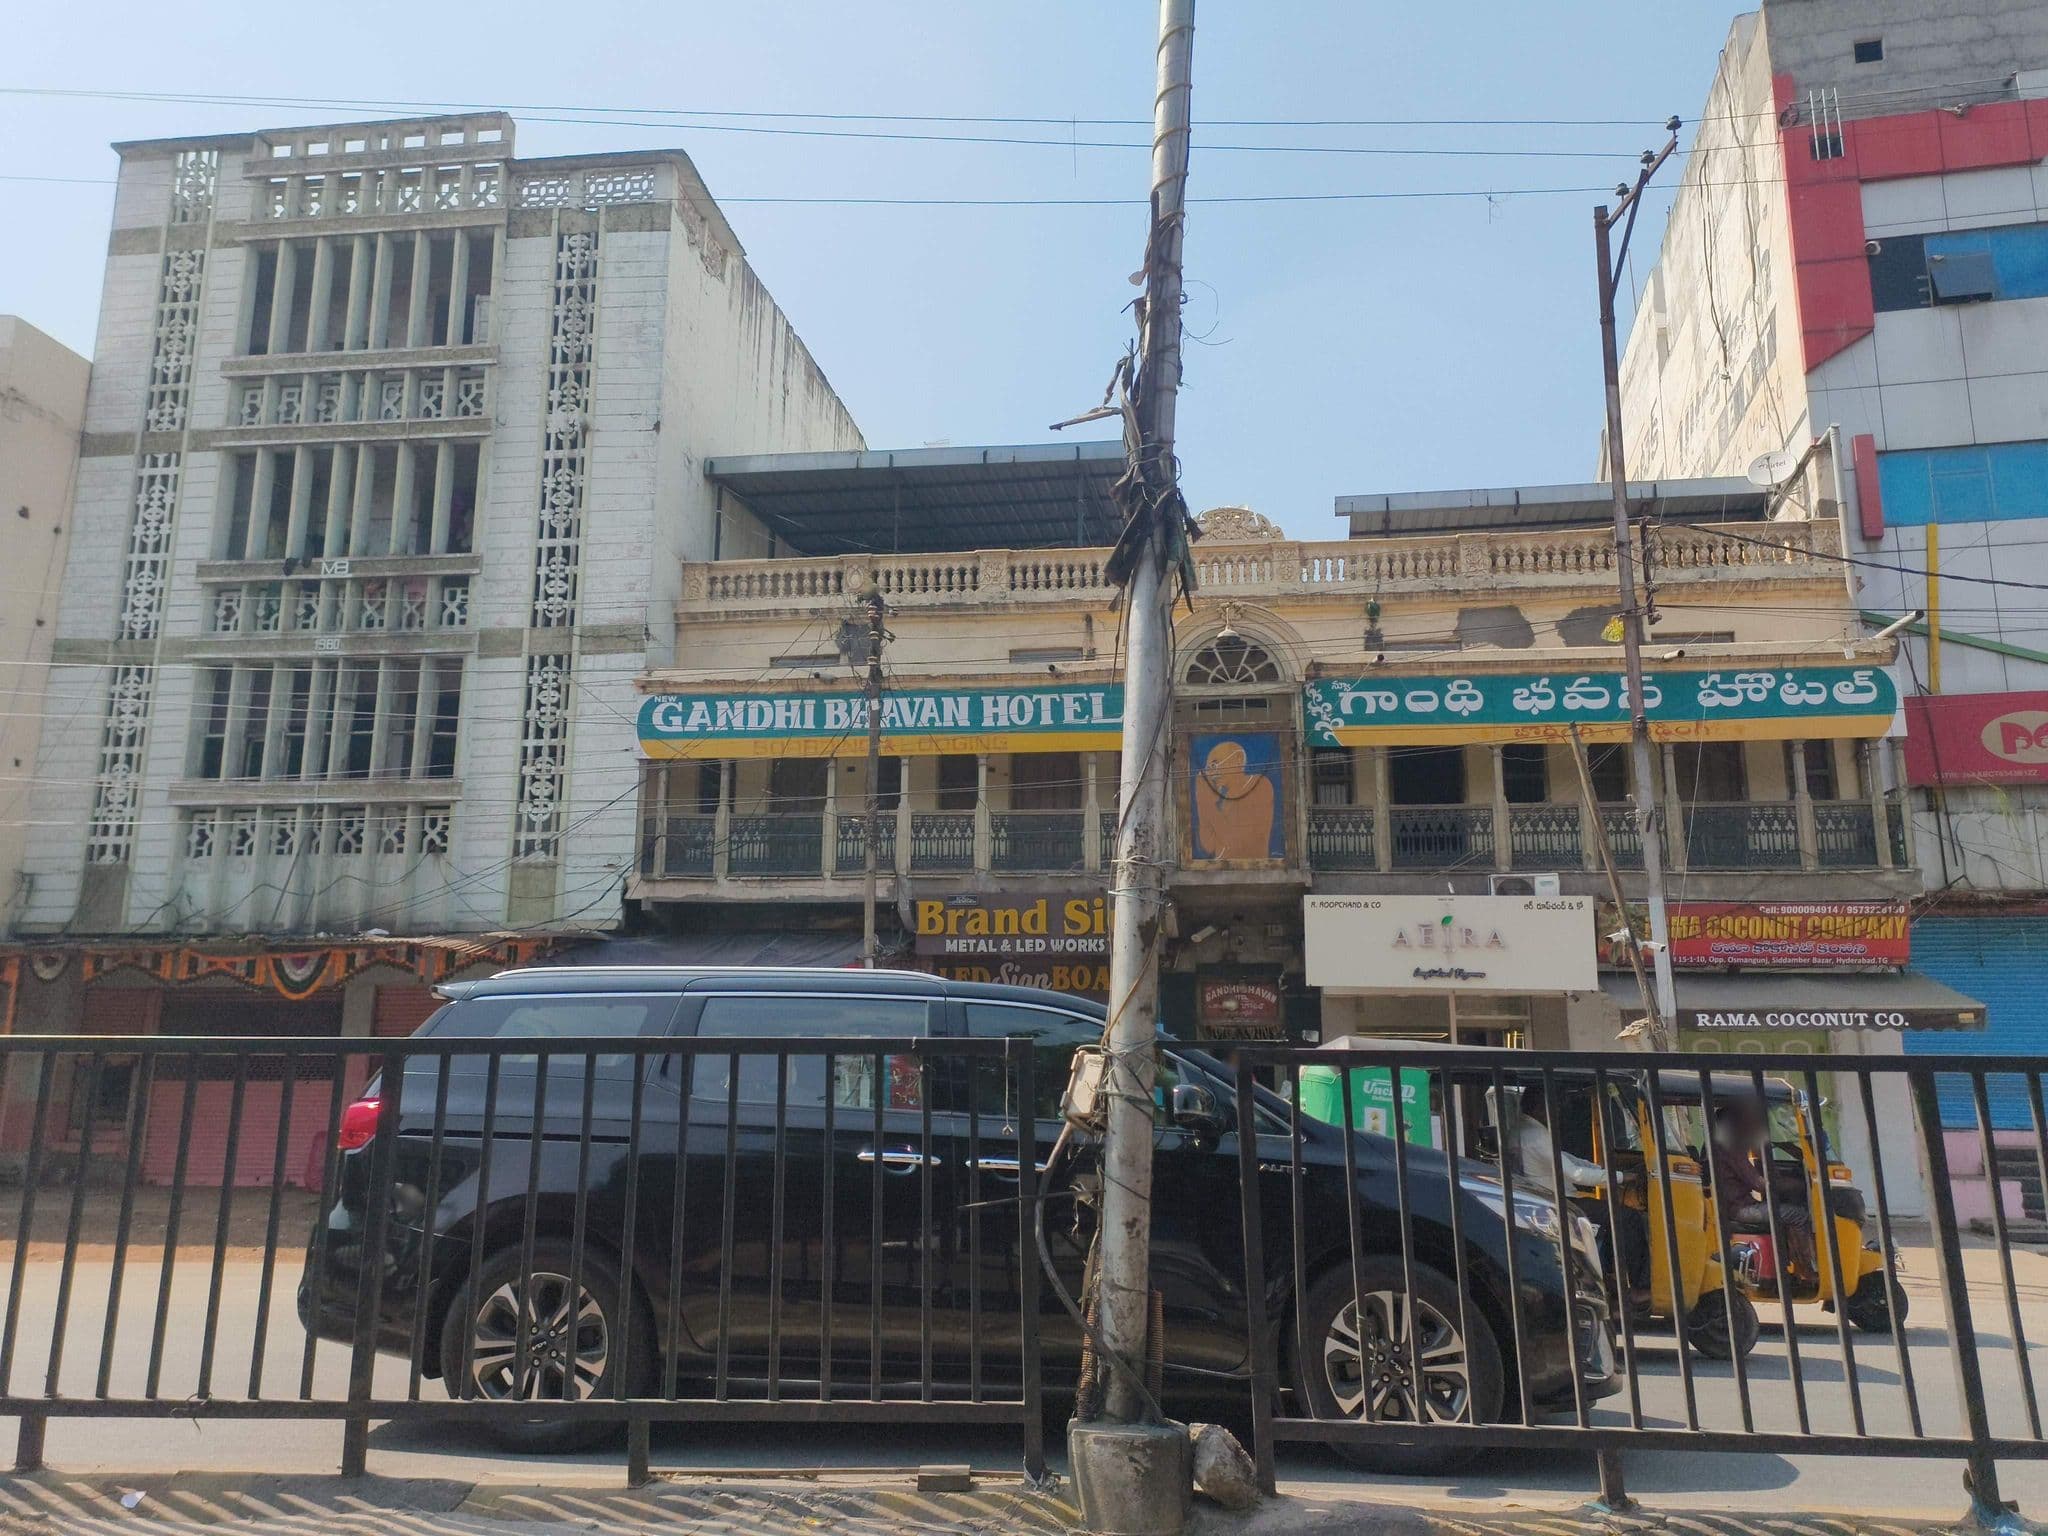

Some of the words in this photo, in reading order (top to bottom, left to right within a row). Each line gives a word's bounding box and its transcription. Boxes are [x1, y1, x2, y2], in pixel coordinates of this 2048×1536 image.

[654, 695, 677, 703] NEW
[1513, 676, 1662, 716] భవన్
[1697, 670, 1878, 708] హోటల్
[652, 699, 816, 732] GANDHI
[824, 696, 970, 729] BHAVAN
[981, 692, 1123, 727] HOTEL
[916, 899, 1048, 935] Brand
[1644, 915, 1701, 940] MA
[1707, 915, 1801, 940] COCONUT
[1807, 915, 1907, 940] COMPANY
[945, 938, 997, 953] METAL
[1000, 939, 1012, 952] &
[1016, 939, 1046, 952] LED
[1051, 939, 1105, 952] WORKS
[1242, 985, 1278, 1004] HAVAN
[1696, 1013, 1761, 1027] RAMA
[1765, 1013, 1868, 1027] COCONUT
[1874, 1013, 1910, 1027] CO.
